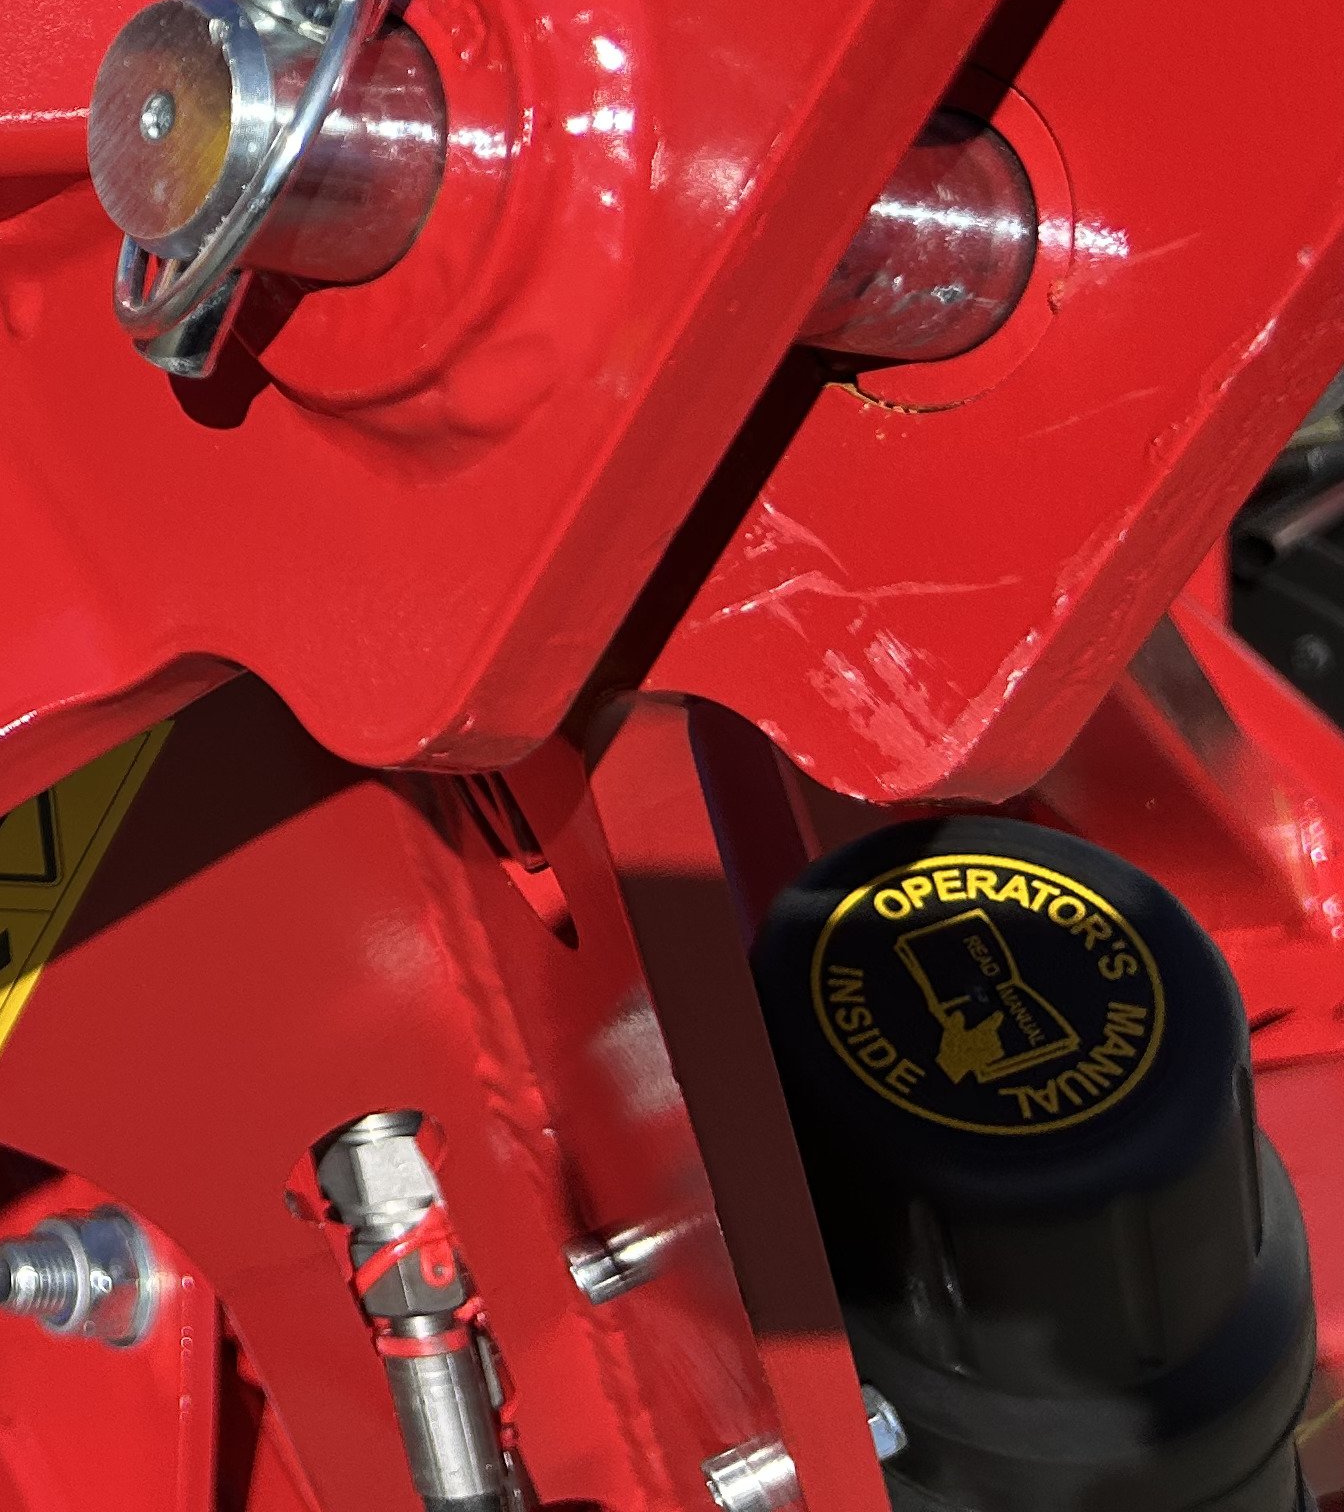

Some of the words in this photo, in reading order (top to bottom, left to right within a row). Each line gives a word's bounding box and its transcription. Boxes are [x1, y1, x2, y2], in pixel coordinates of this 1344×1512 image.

[872, 868, 1139, 981] OPERATOR'S
[961, 934, 1001, 978] READ
[826, 964, 926, 1095] INSIDE
[999, 1001, 1150, 1120] MANUAL
